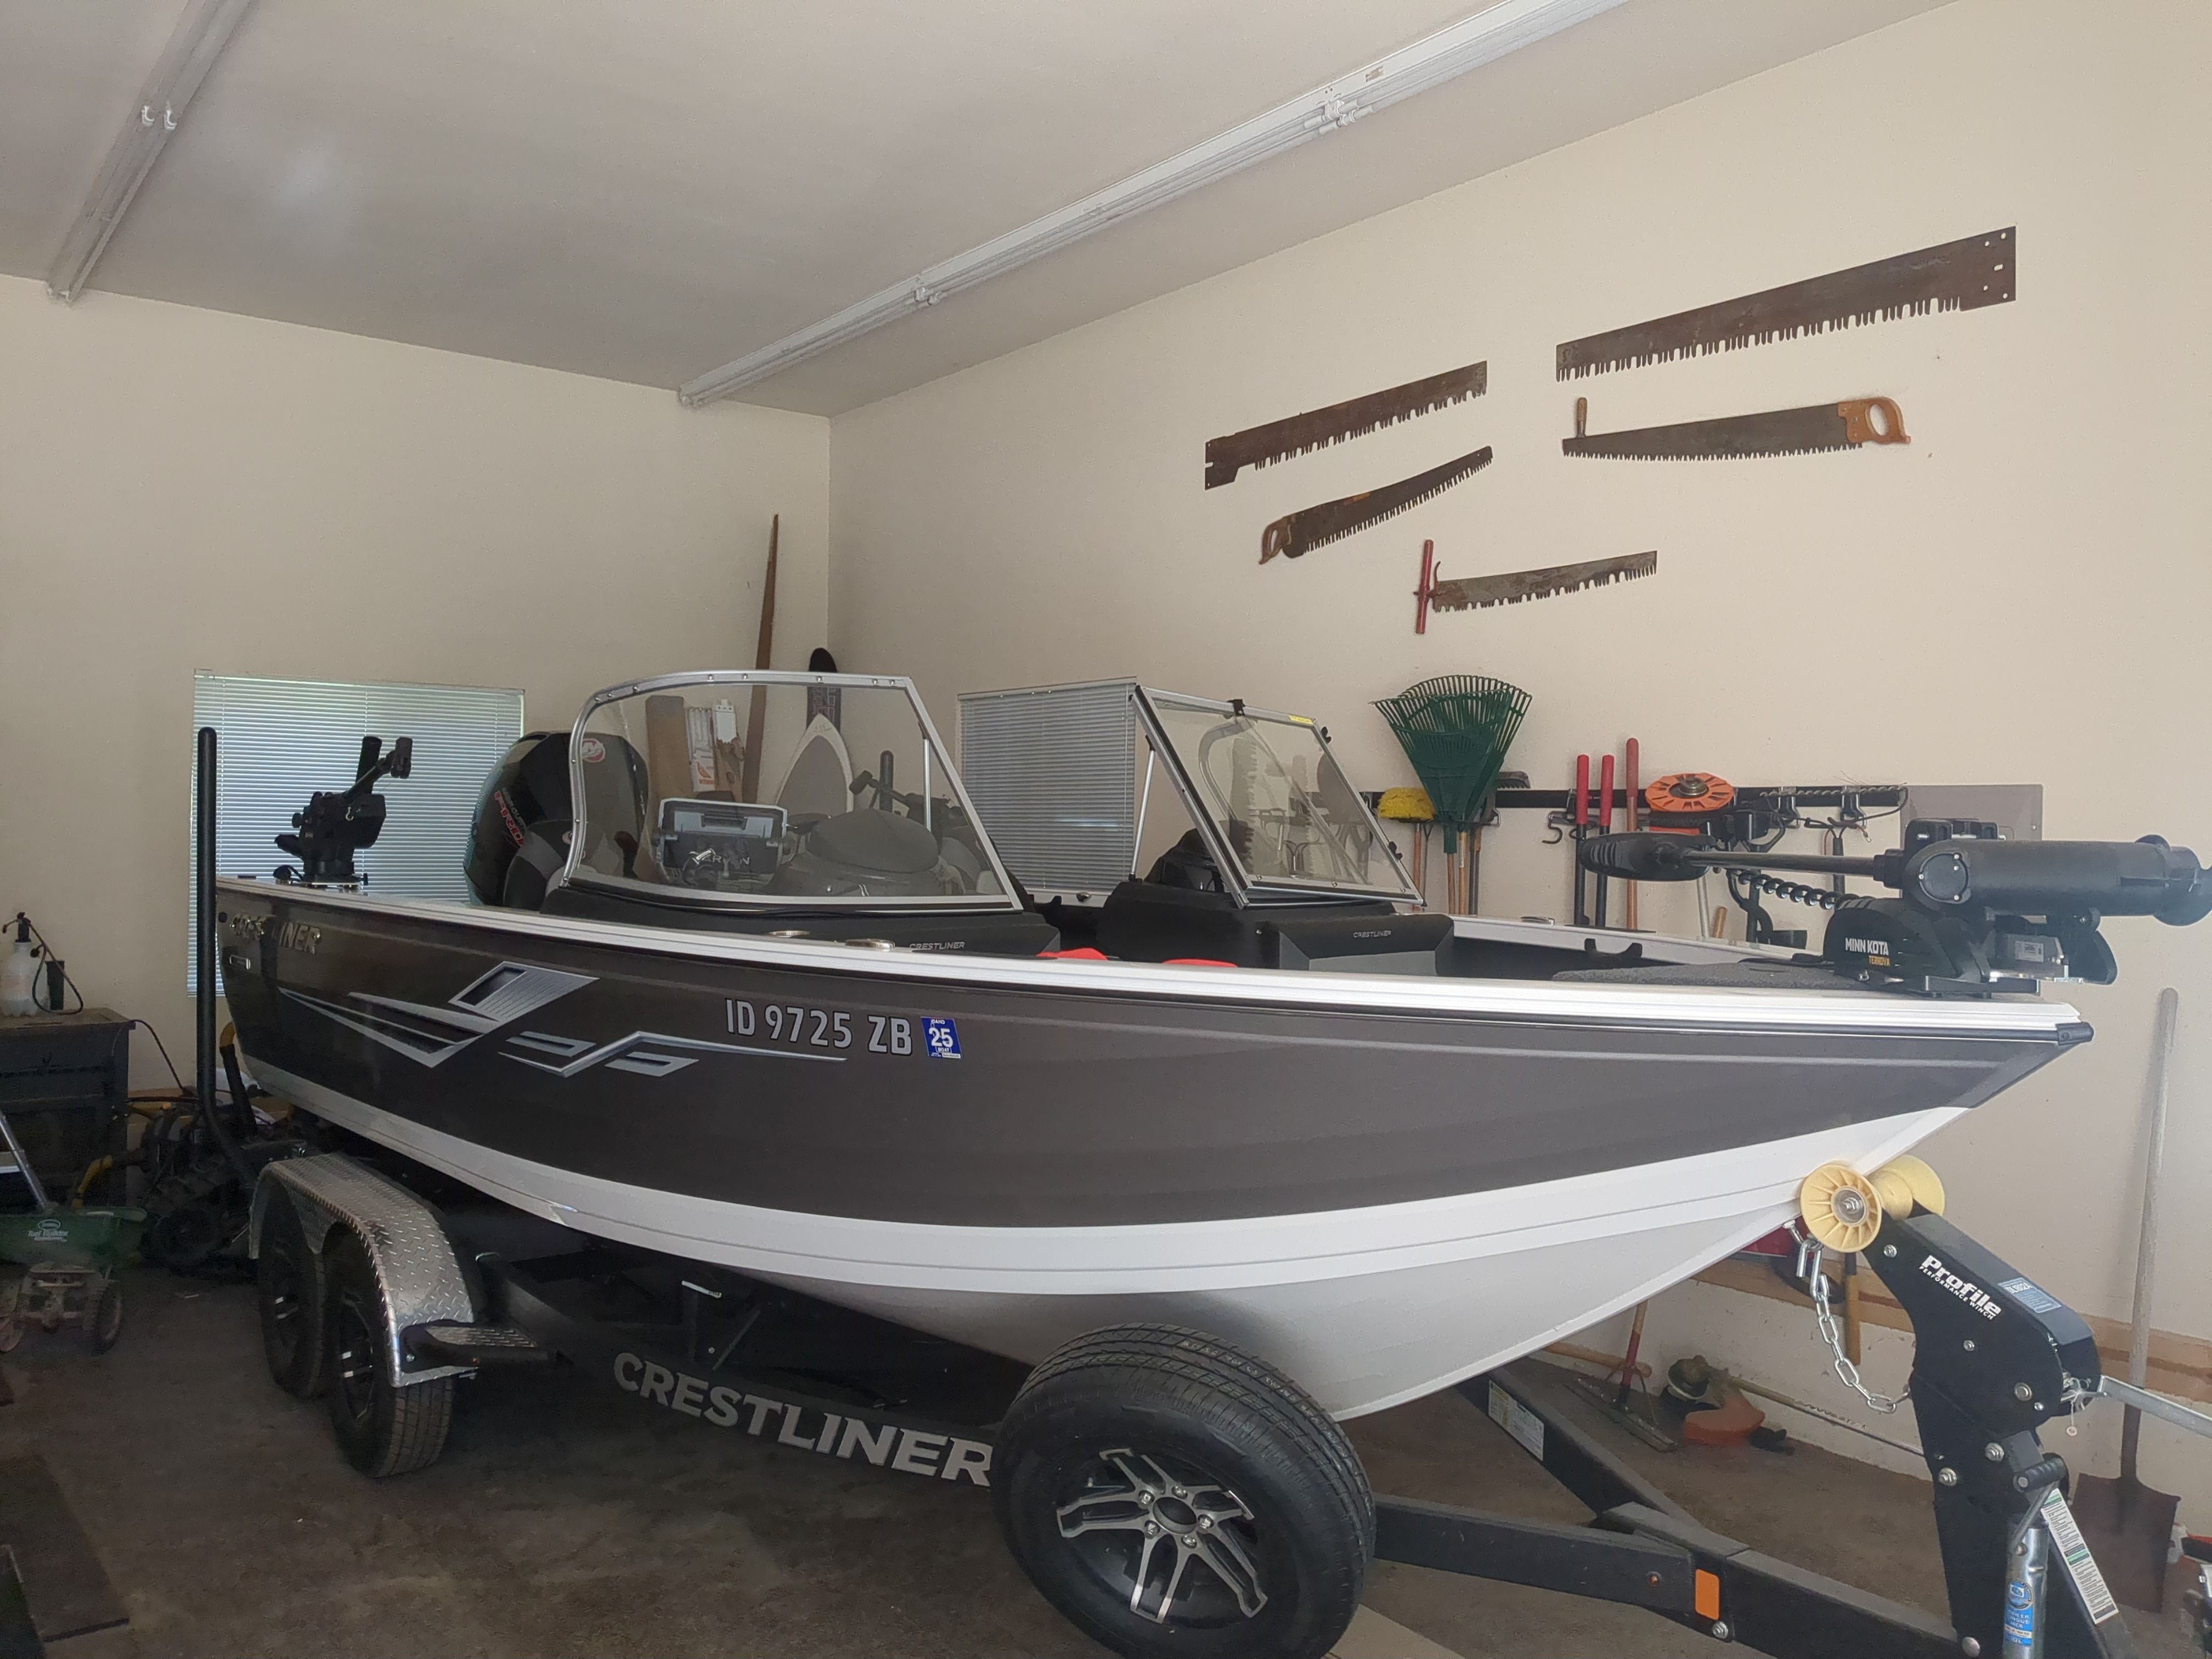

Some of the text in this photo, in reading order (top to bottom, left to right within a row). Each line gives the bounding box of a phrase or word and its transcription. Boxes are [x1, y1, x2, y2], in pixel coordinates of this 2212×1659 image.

[909, 941, 966, 950] CRESTLINER
[1353, 930, 1392, 938] CRESTLINER
[1845, 937, 1889, 956] MINN KOTA
[725, 998, 913, 1056] ID 9725 ZB
[928, 1027, 953, 1048] 25
[1919, 1266, 1994, 1320] PERFORMANCE WINCH
[1921, 1255, 2001, 1317] Profile
[613, 1352, 994, 1487] CRESTLINER
